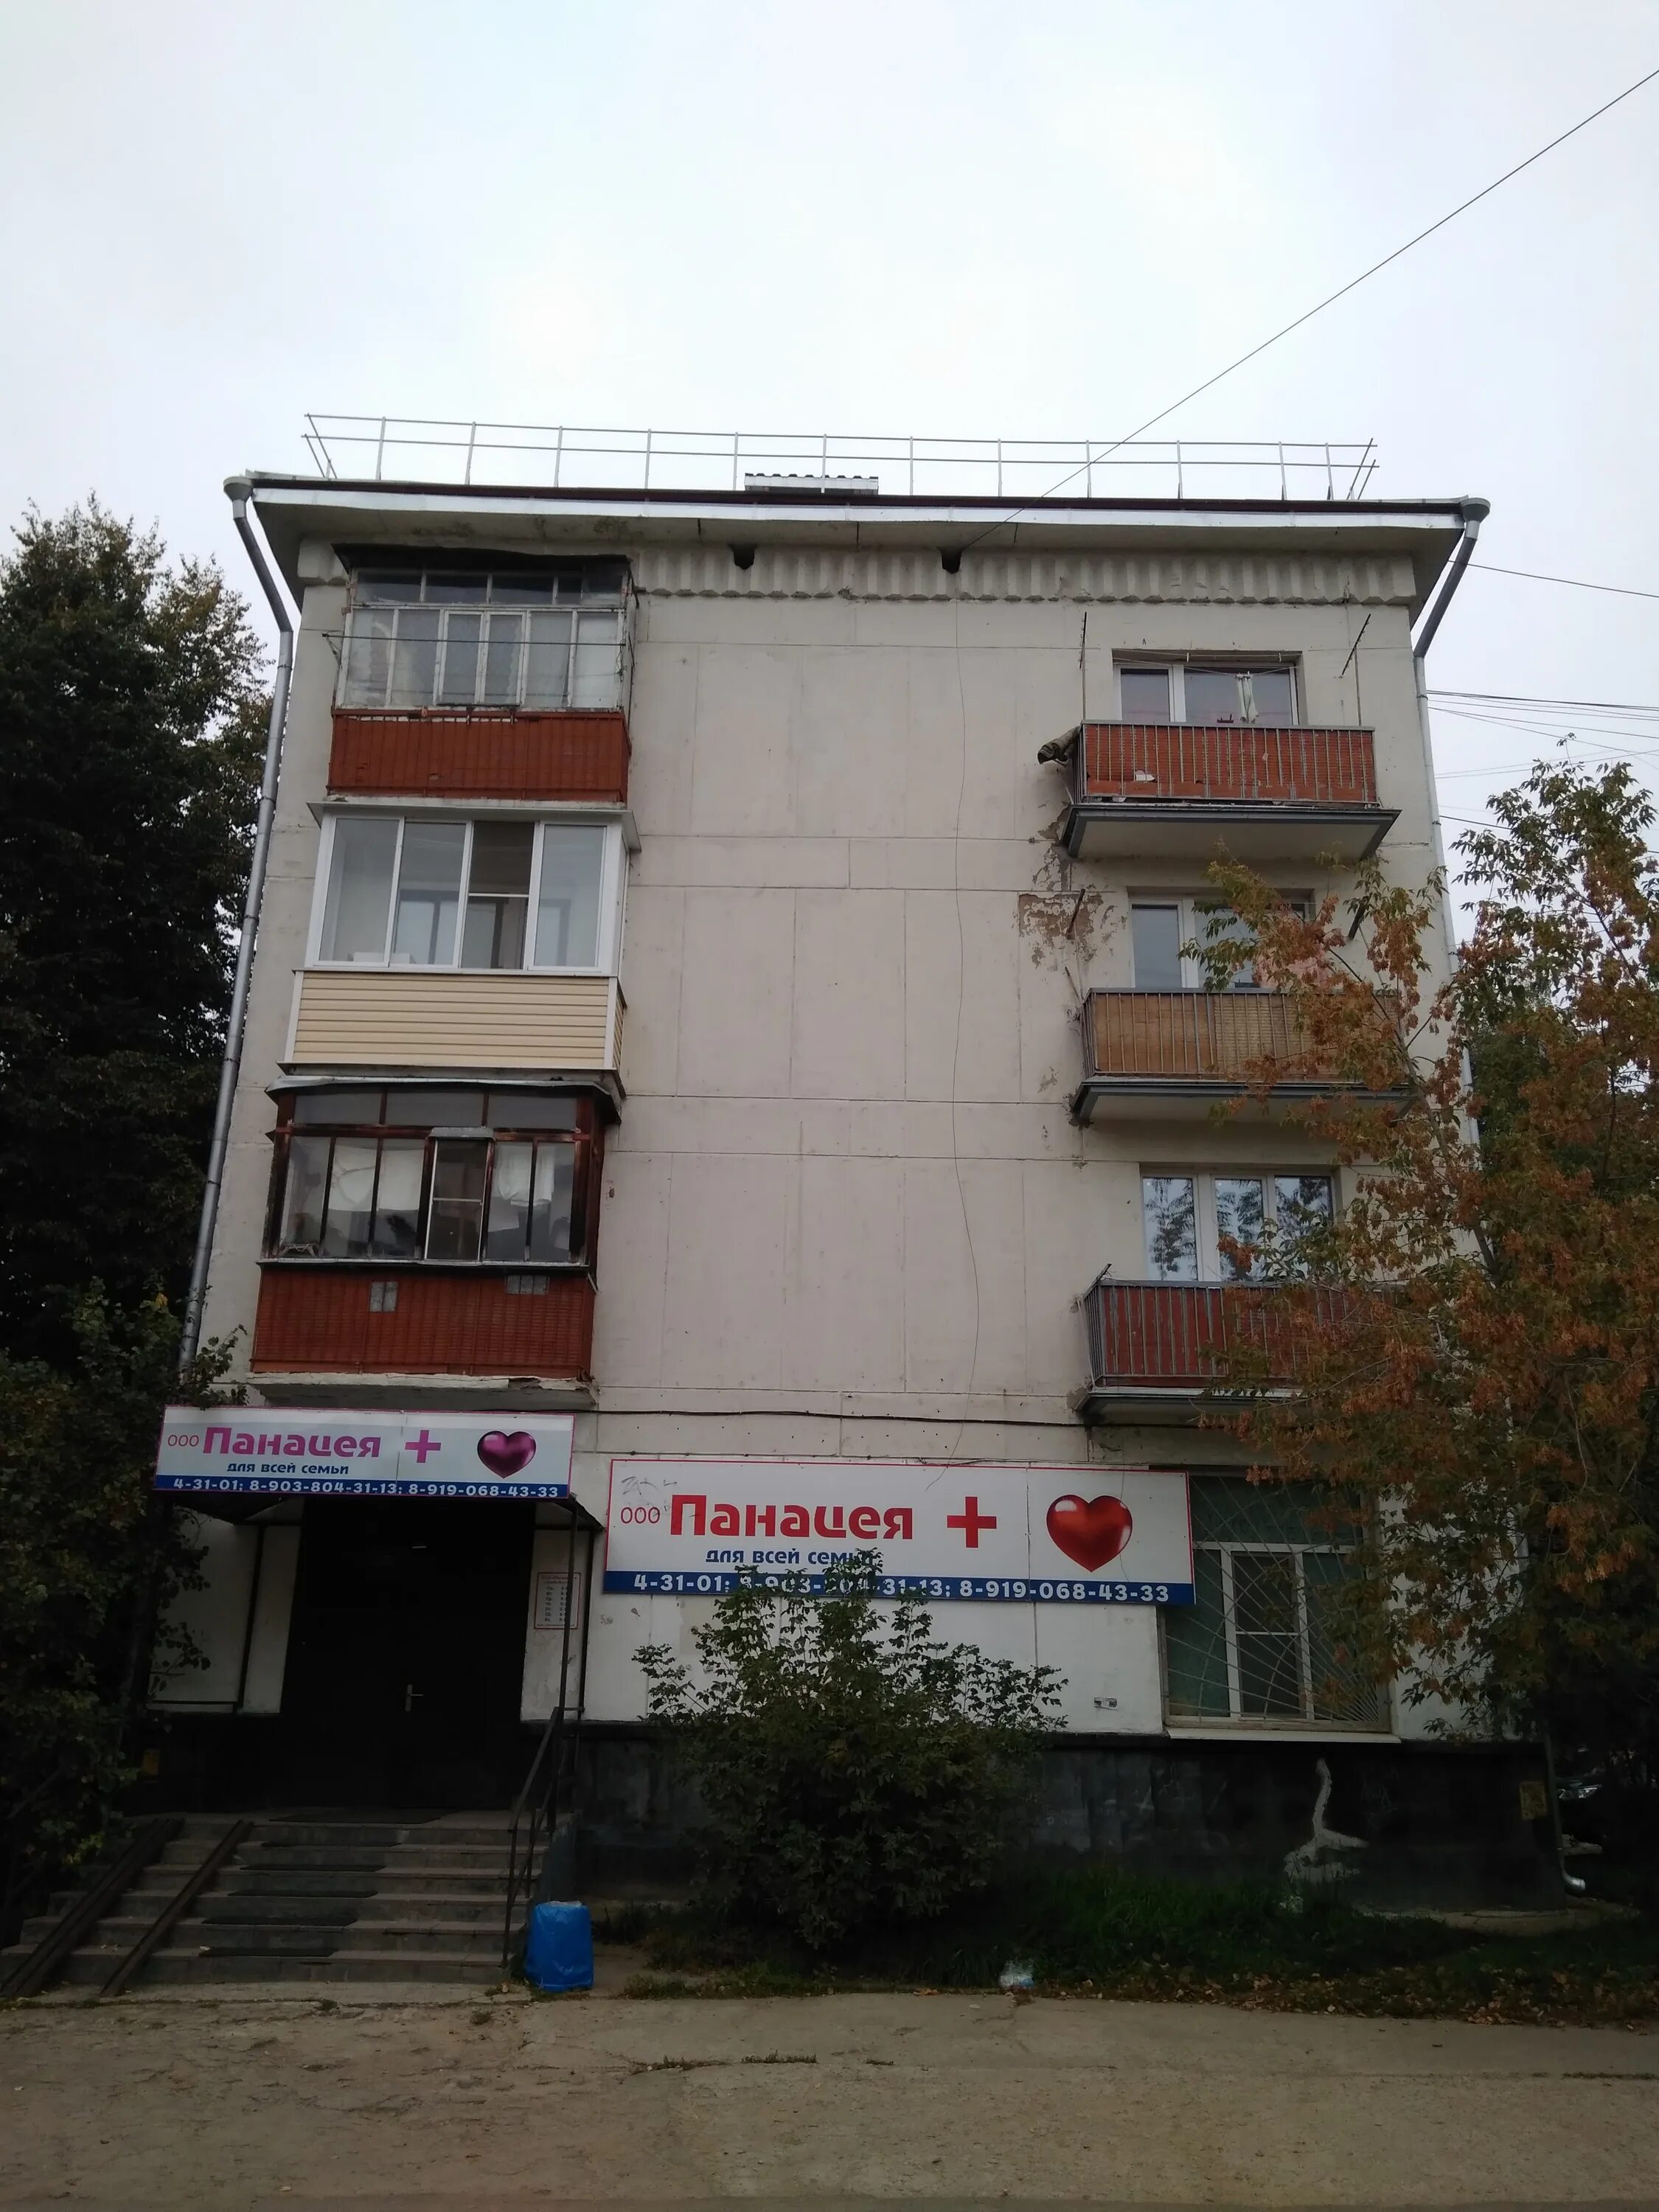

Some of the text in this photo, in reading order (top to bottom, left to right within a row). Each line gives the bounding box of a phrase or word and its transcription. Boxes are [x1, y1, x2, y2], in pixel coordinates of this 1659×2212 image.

[167, 1427, 381, 1458] ООО Панацея
[226, 1462, 349, 1475] для всей семьи
[408, 1483, 558, 1498] 8-919-068-43-33
[620, 1494, 913, 1540] ООО Панацея
[705, 1550, 744, 1563] для
[752, 1548, 800, 1565] всей
[959, 1579, 1169, 1602] 8-919-068-43-33
